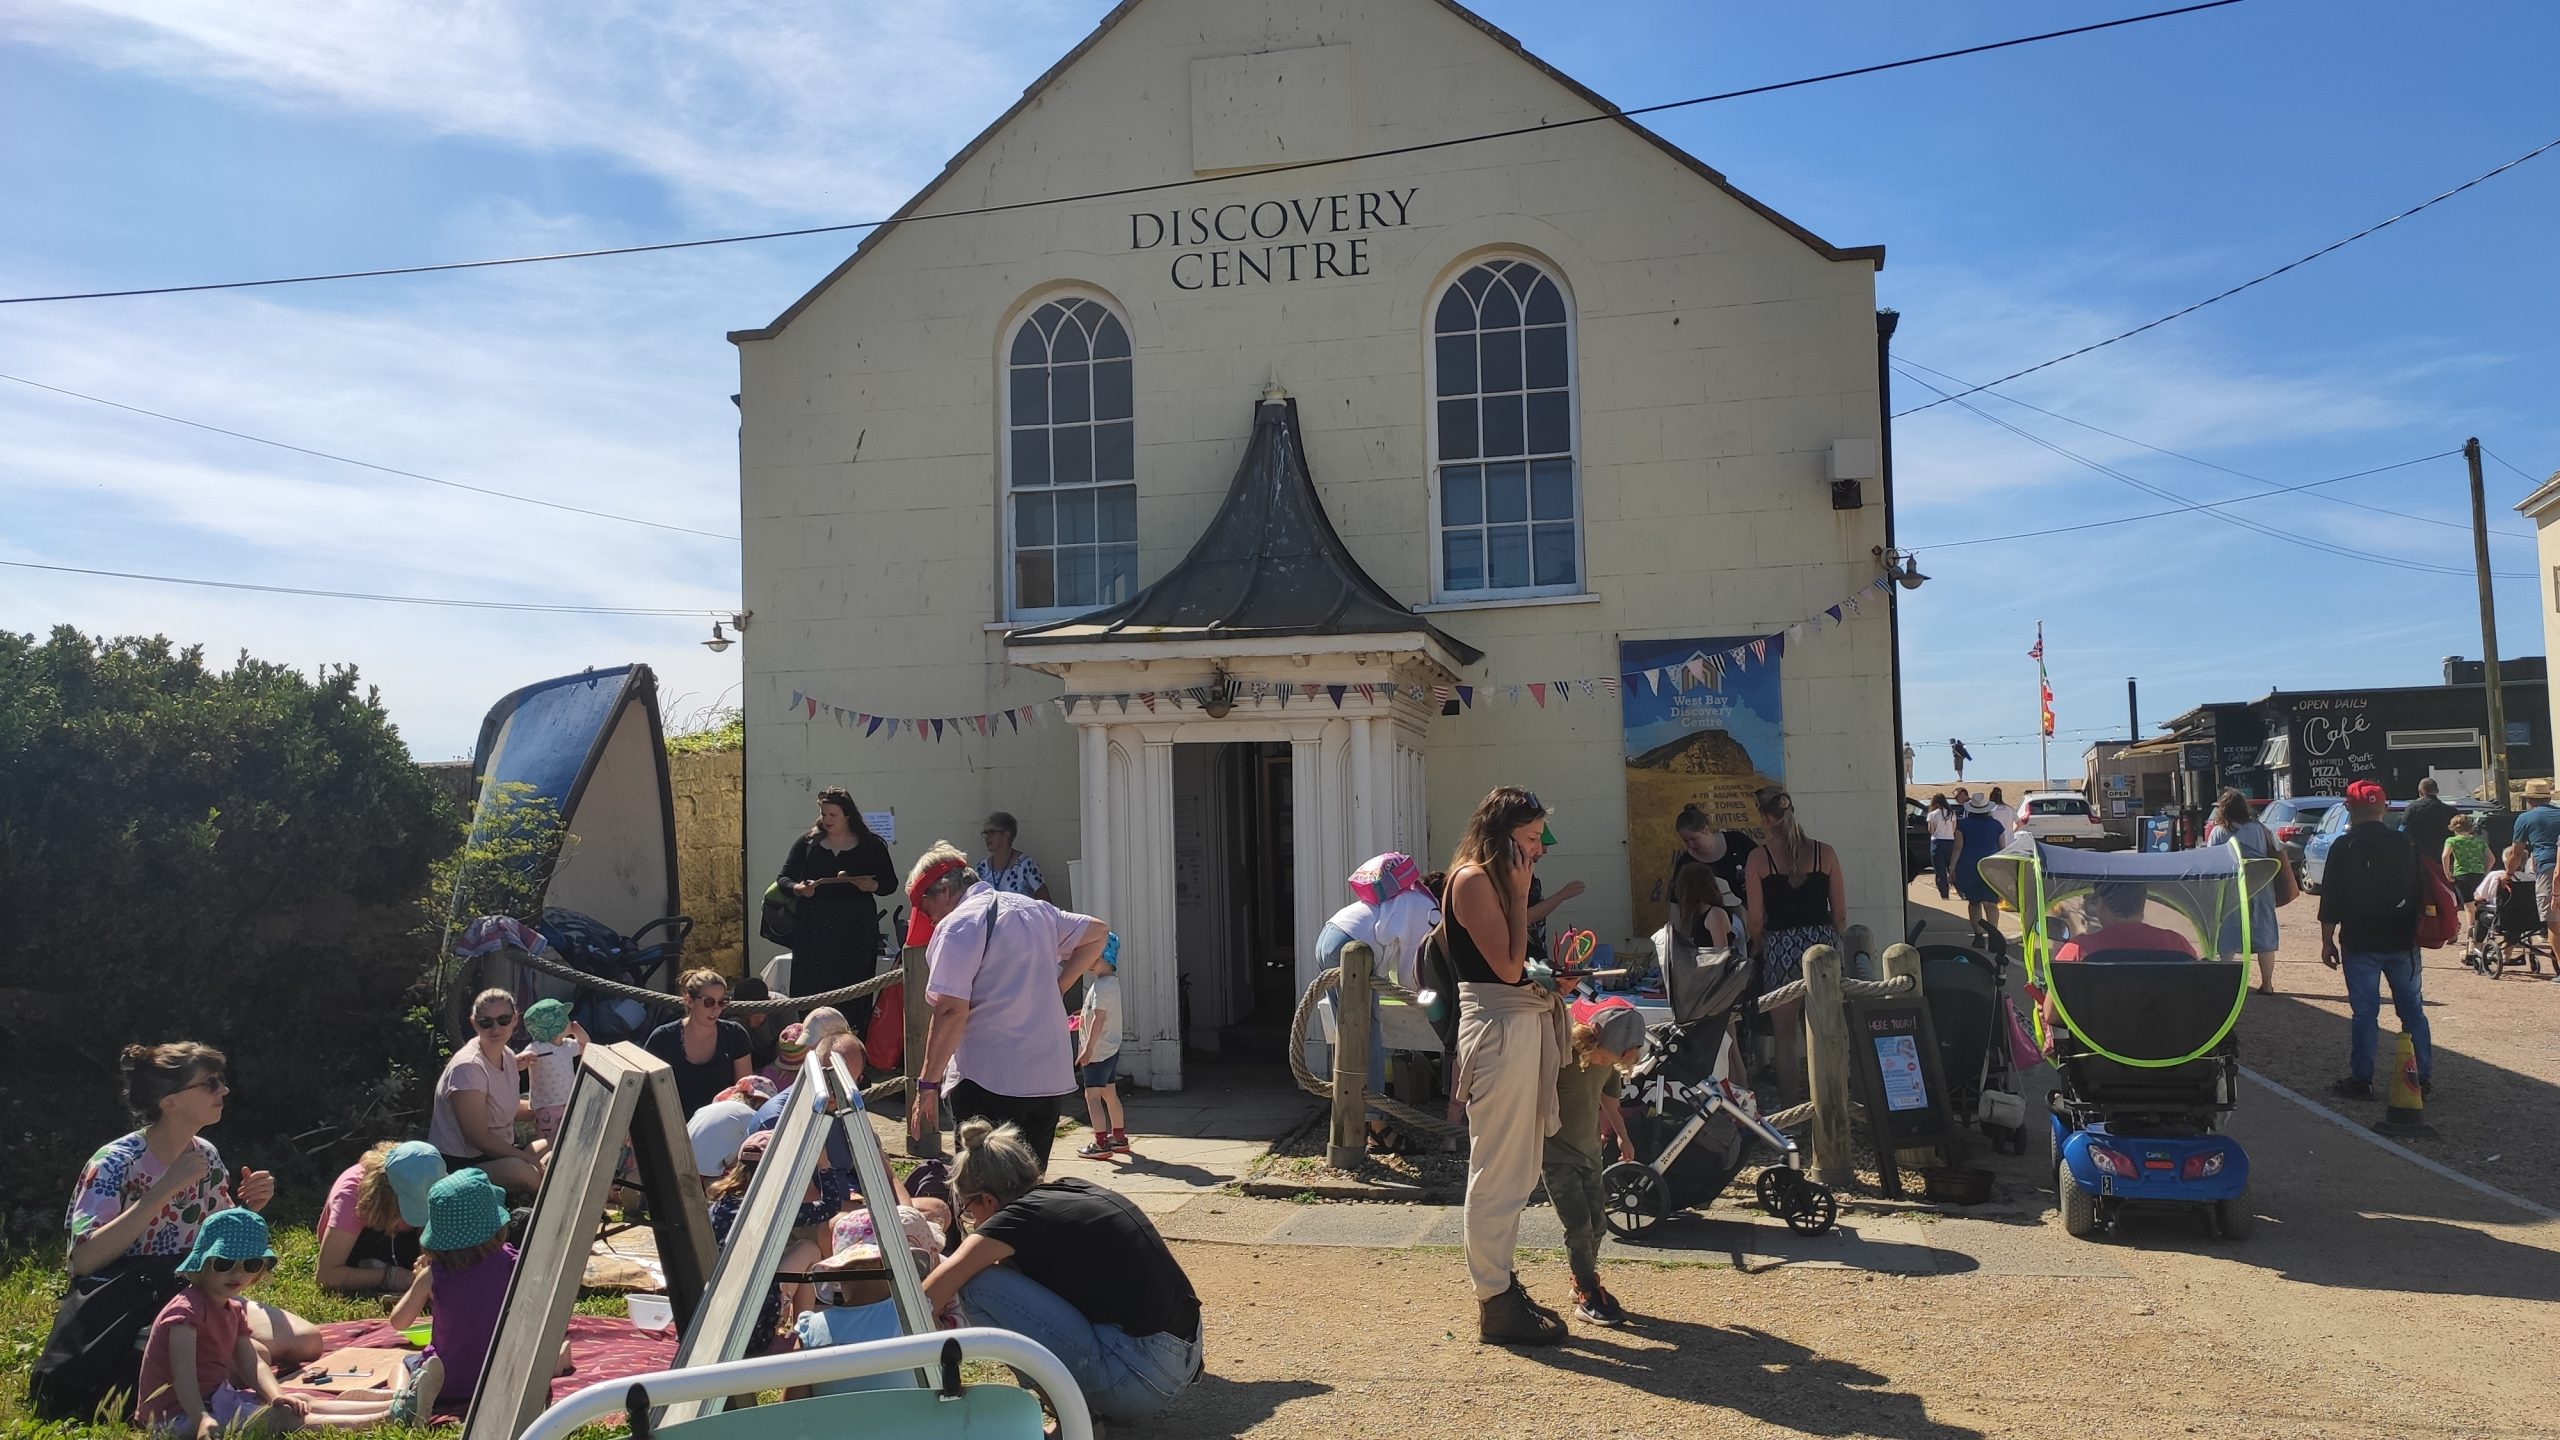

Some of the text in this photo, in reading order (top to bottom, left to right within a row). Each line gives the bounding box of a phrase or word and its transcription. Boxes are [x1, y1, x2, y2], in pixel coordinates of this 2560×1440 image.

[1129, 187, 1420, 250] DISCOVERY
[1171, 238, 1370, 290] CENTRE
[1672, 695, 1728, 708] West Bay
[2299, 698, 2367, 710] OPEN DAILY
[1670, 706, 1732, 718] Discovery
[1681, 717, 1722, 728] Centre
[2303, 713, 2371, 756] Café
[2312, 766, 2342, 777] PIZZA
[2352, 762, 2376, 772] Beer
[2309, 777, 2349, 789] LOBSTER
[1867, 1015, 1918, 1031] HERE TODAY!
